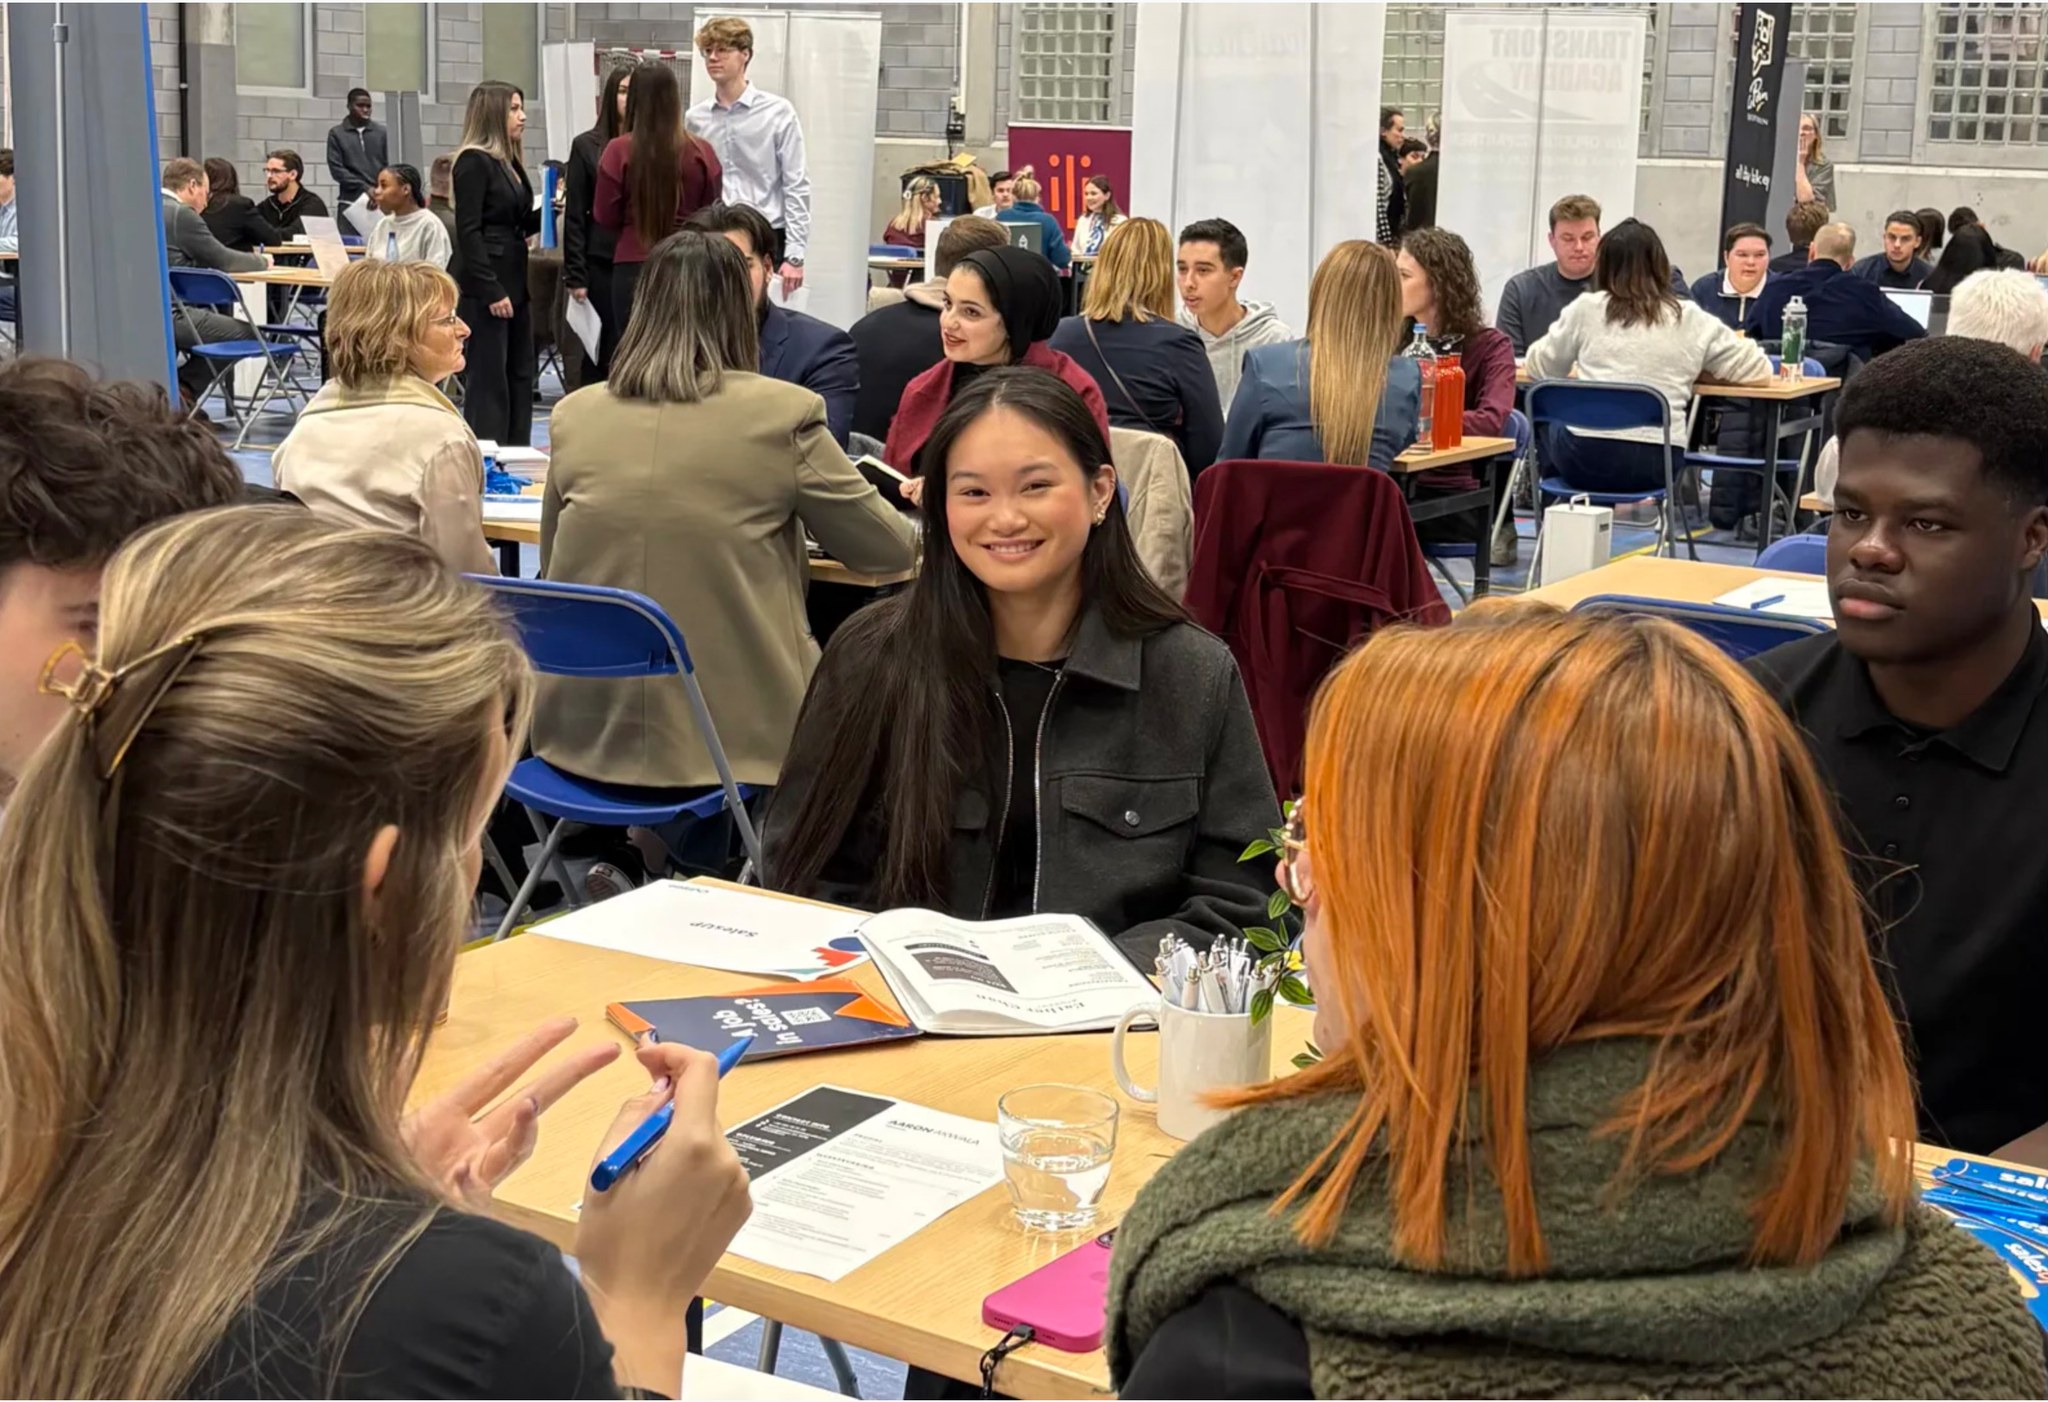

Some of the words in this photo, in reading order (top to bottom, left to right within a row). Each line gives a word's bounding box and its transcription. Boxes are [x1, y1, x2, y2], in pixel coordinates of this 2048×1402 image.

[712, 1010, 757, 1029] job
[734, 998, 788, 1031] sales?
[888, 1120, 934, 1133] AARON
[1999, 1173, 2048, 1190] sal
